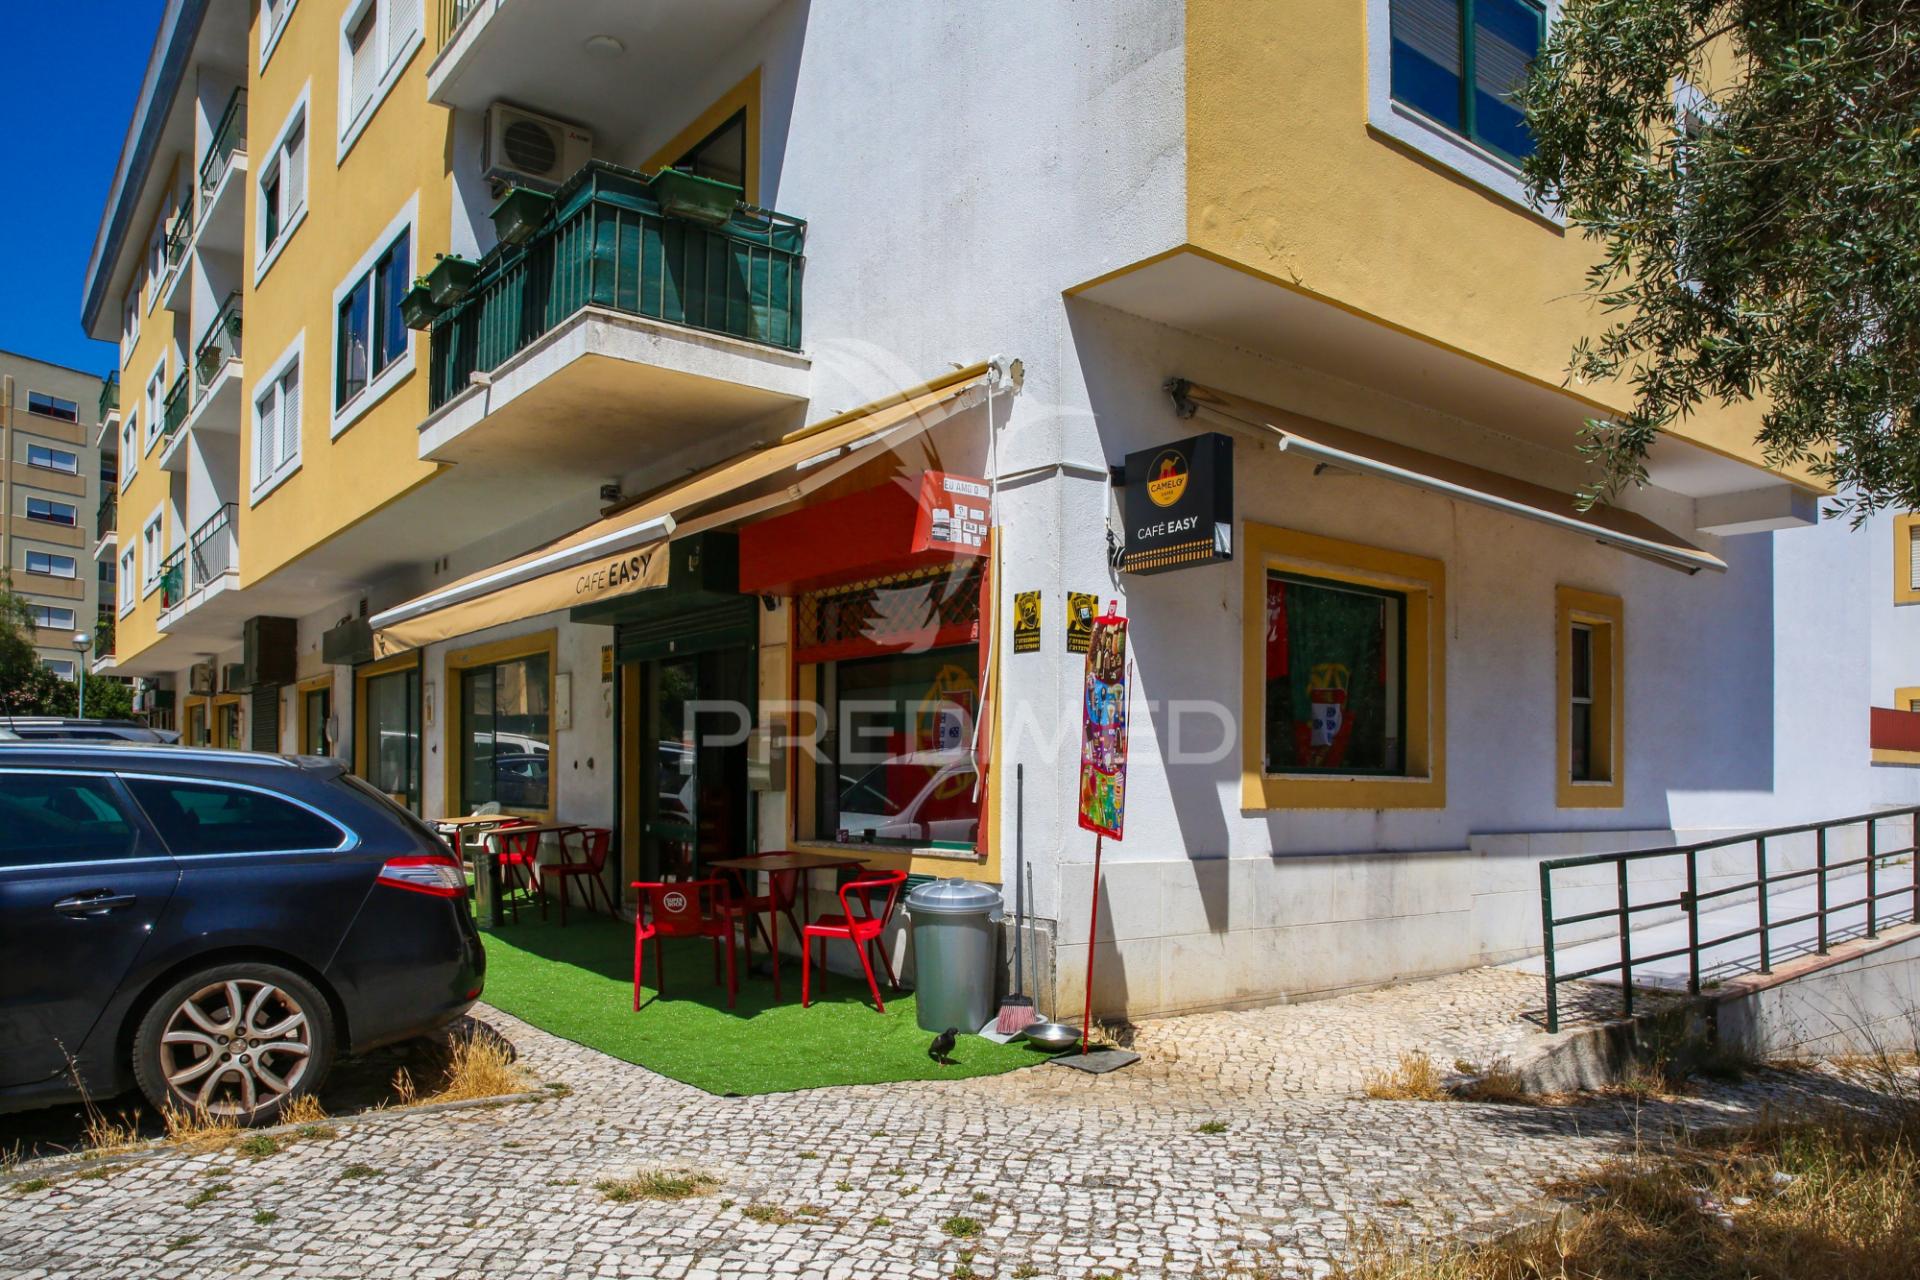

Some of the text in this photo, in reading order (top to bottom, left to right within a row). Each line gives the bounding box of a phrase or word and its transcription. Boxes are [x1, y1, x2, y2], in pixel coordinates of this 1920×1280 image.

[1151, 477, 1184, 493] CAMELO
[1137, 515, 1198, 540] CAFÉ EASY
[608, 553, 653, 587] EASY
